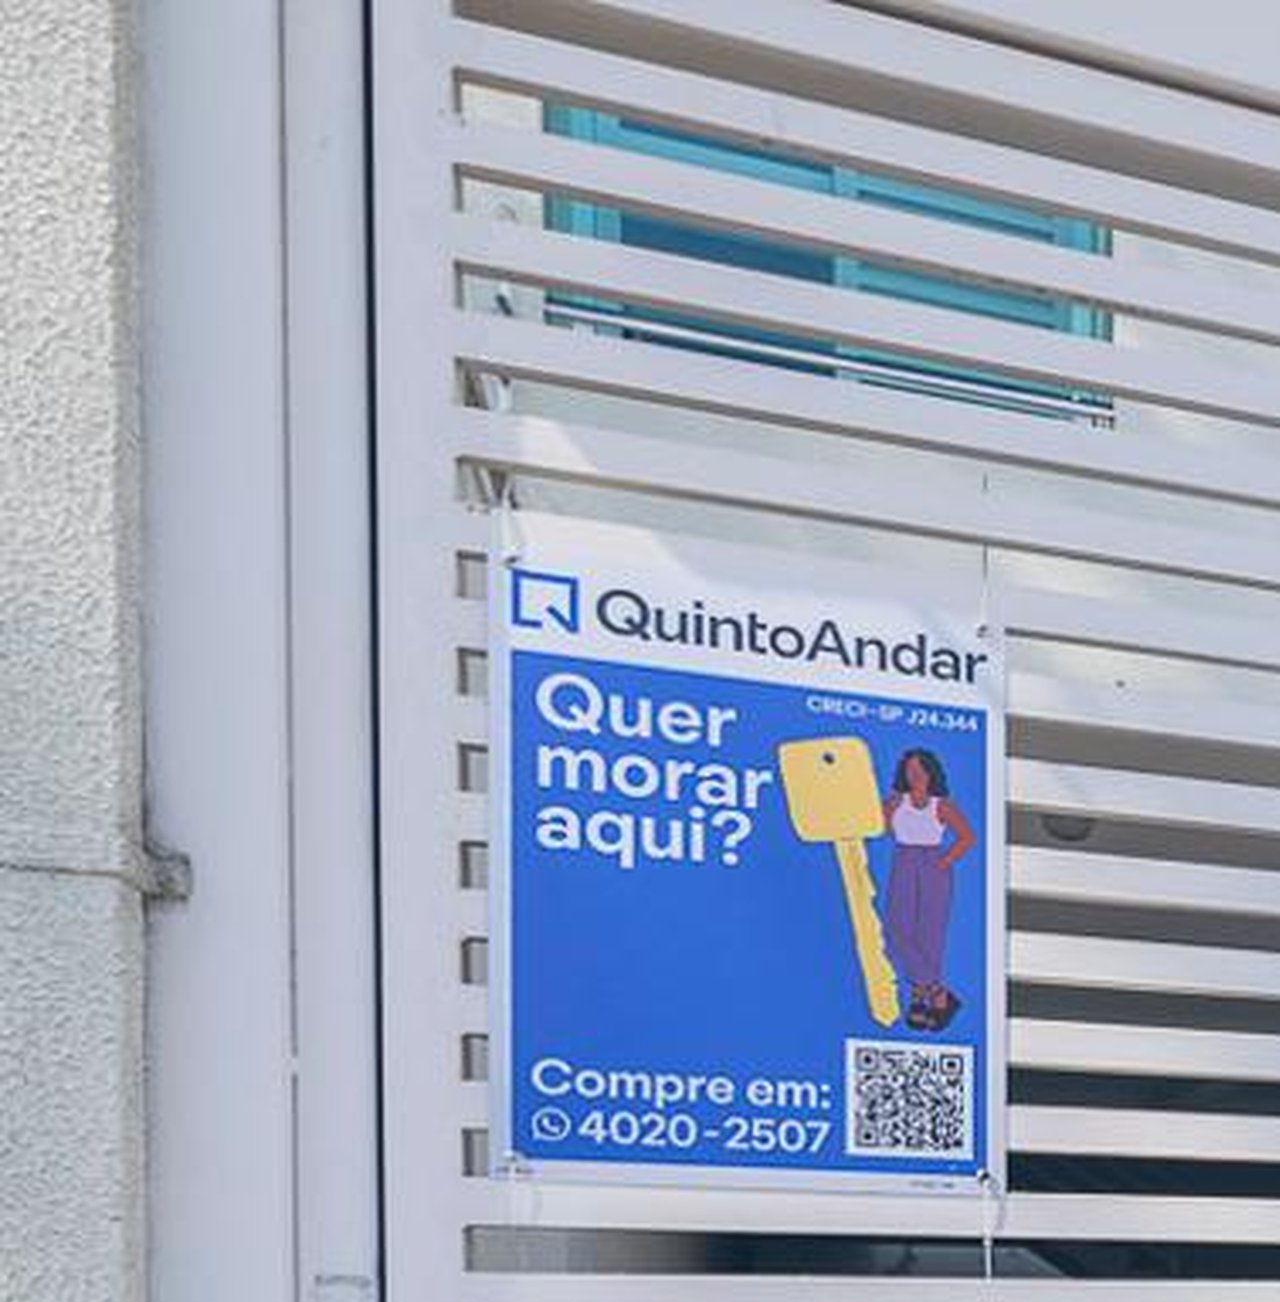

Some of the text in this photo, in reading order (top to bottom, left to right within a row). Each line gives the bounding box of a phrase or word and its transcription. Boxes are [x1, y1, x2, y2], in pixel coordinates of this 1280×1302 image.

[595, 588, 989, 684] QuintoAndar
[535, 672, 738, 748] Quer
[806, 694, 903, 722] CRECI-SP
[536, 743, 774, 809] morar
[535, 804, 752, 869] aqui?
[531, 1057, 833, 1110] Compre em:
[578, 1110, 832, 1153] 4020-2507
